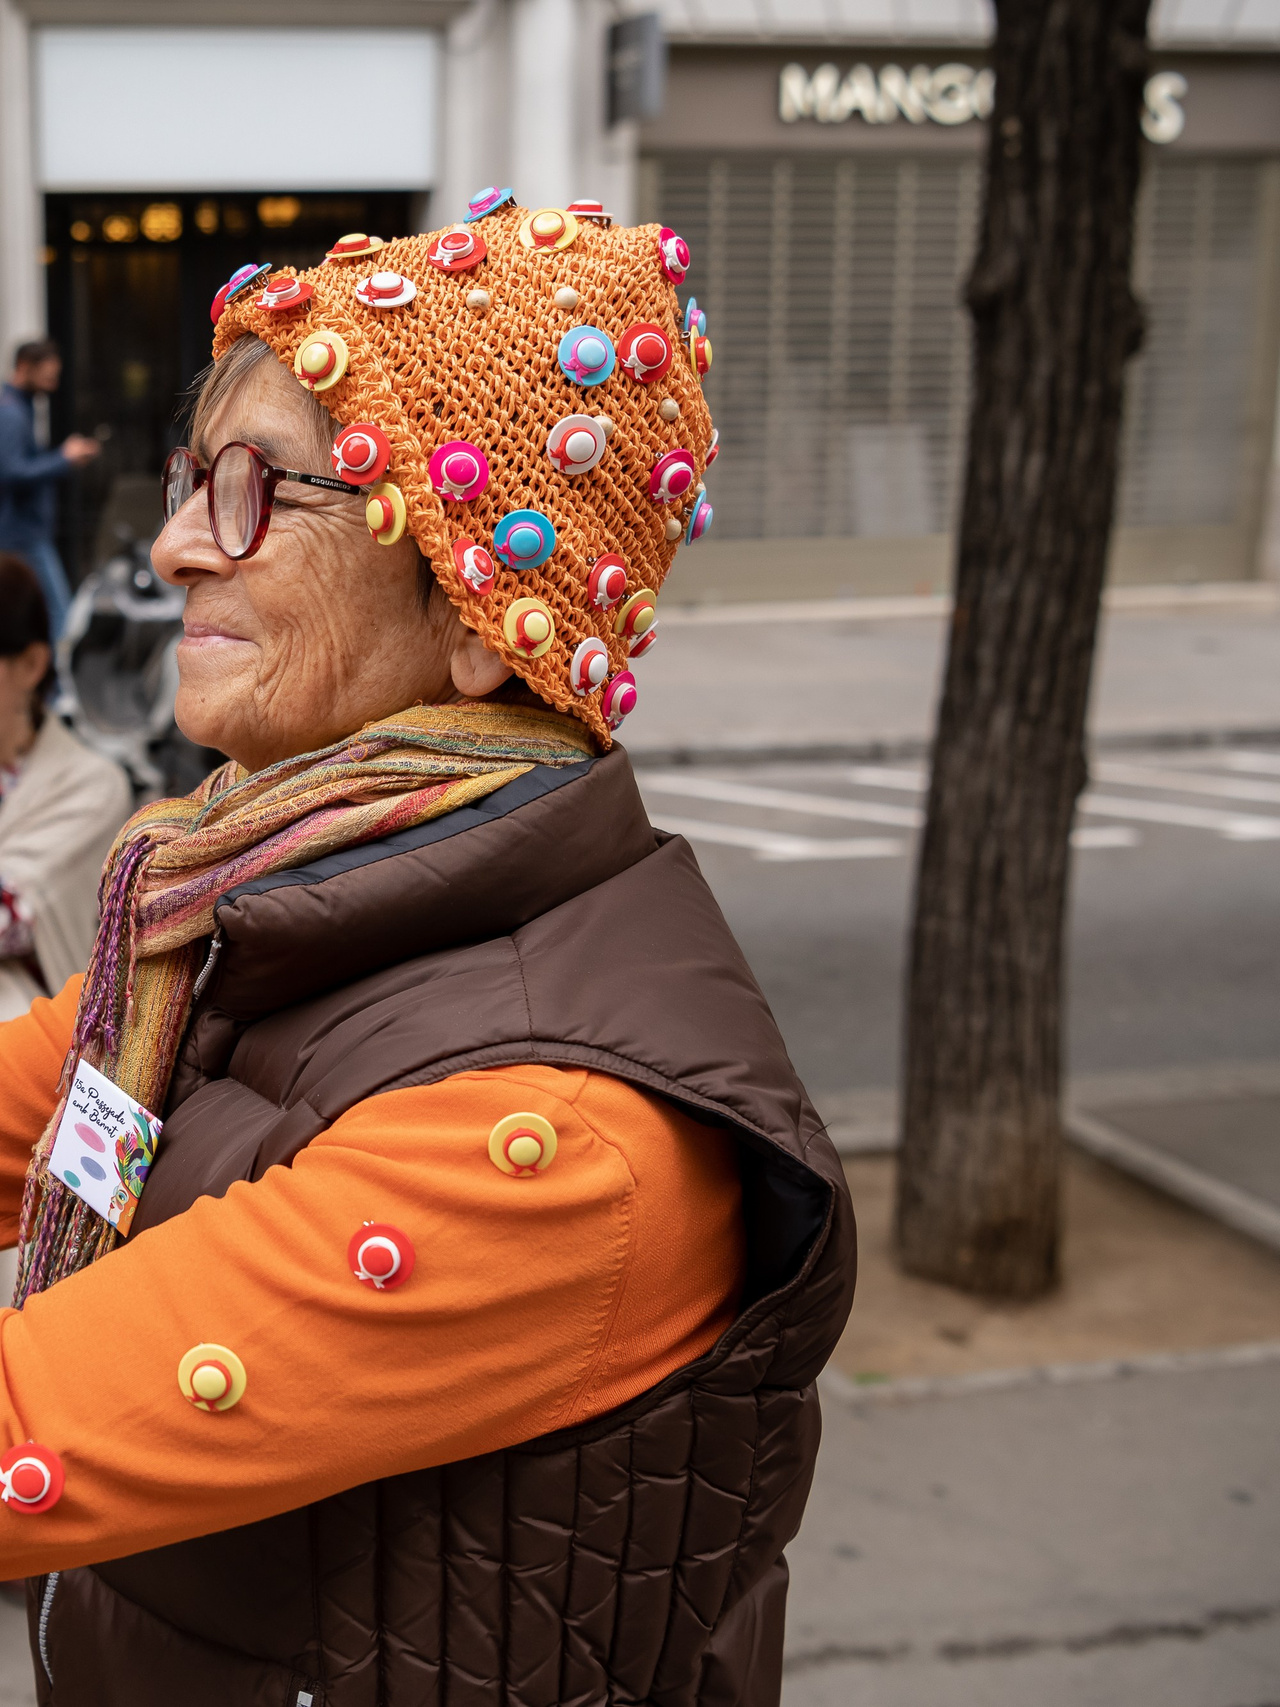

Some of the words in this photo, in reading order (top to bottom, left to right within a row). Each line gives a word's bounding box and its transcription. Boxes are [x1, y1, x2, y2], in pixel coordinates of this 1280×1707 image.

[72, 1099, 89, 1114] amb
[89, 1108, 119, 1138] Barret
[87, 1086, 125, 1125] Passejada
